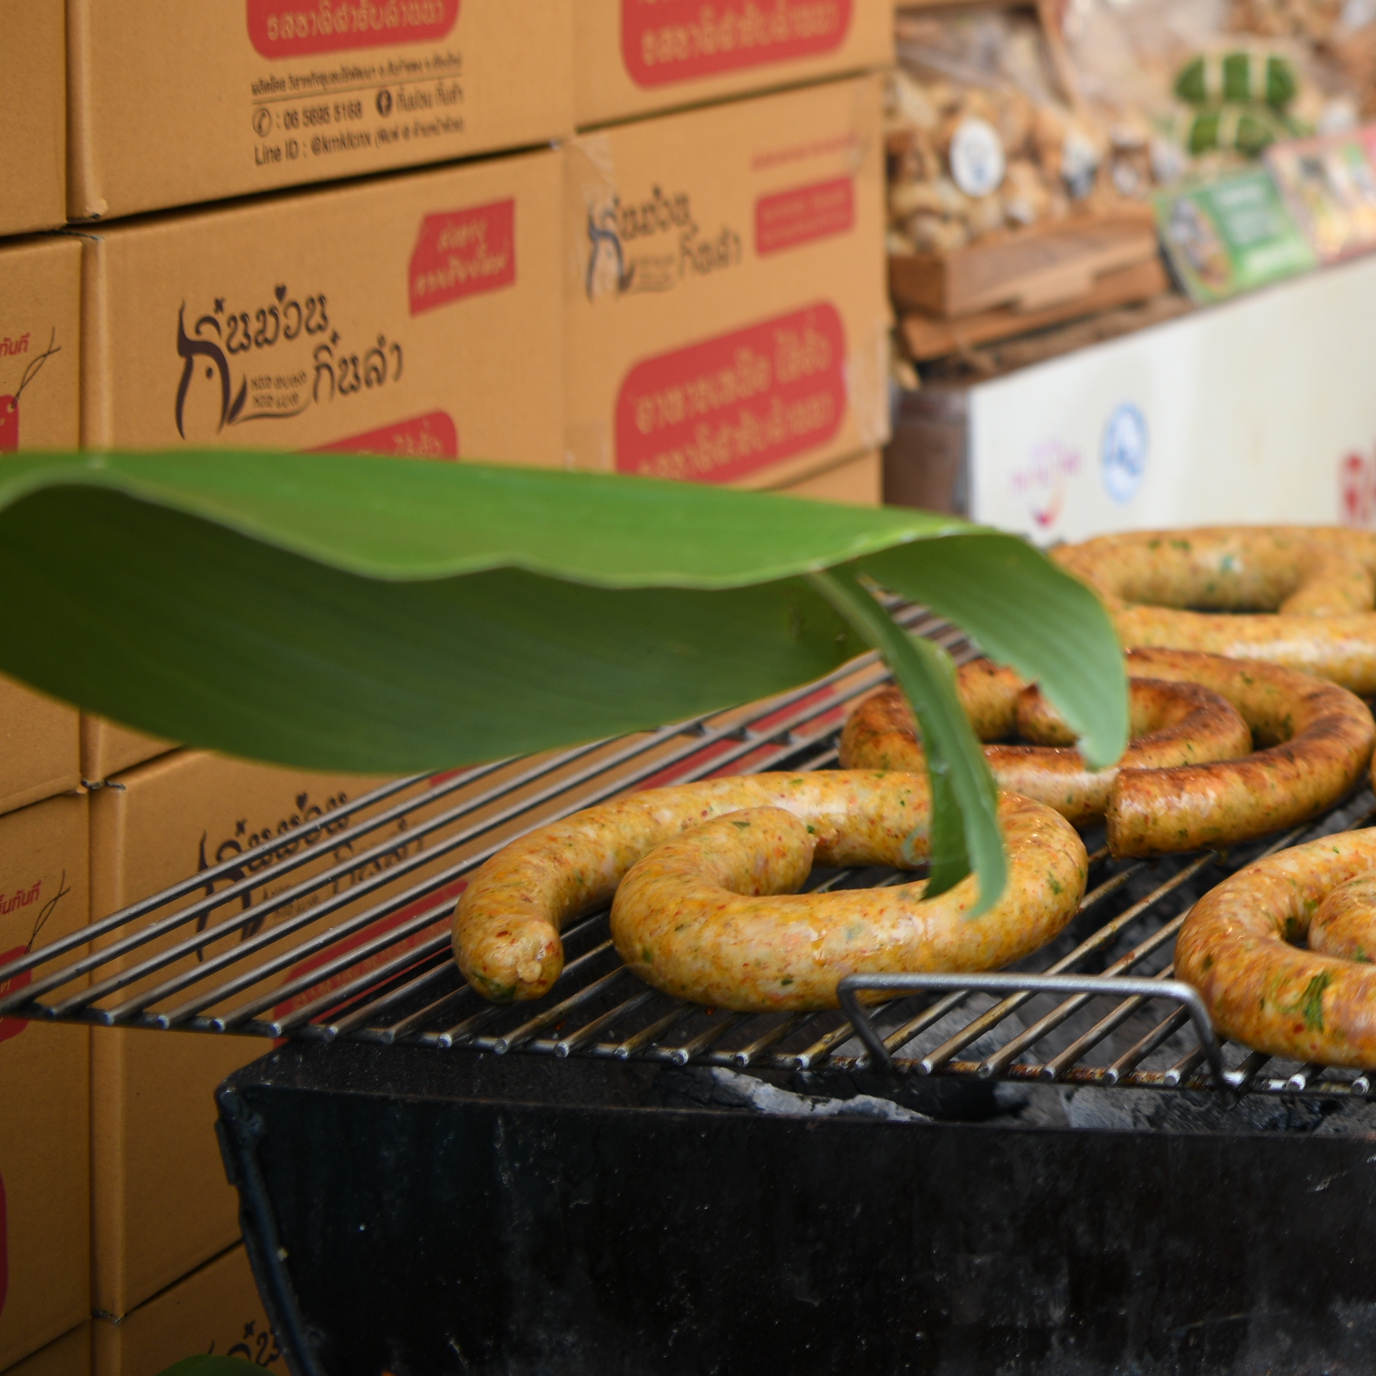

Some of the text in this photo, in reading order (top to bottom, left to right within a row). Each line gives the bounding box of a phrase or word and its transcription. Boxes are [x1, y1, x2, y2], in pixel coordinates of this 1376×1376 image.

[283, 109, 300, 132] 06
[302, 104, 331, 129] 5695
[254, 144, 282, 167] Line
[285, 138, 299, 161] ID
